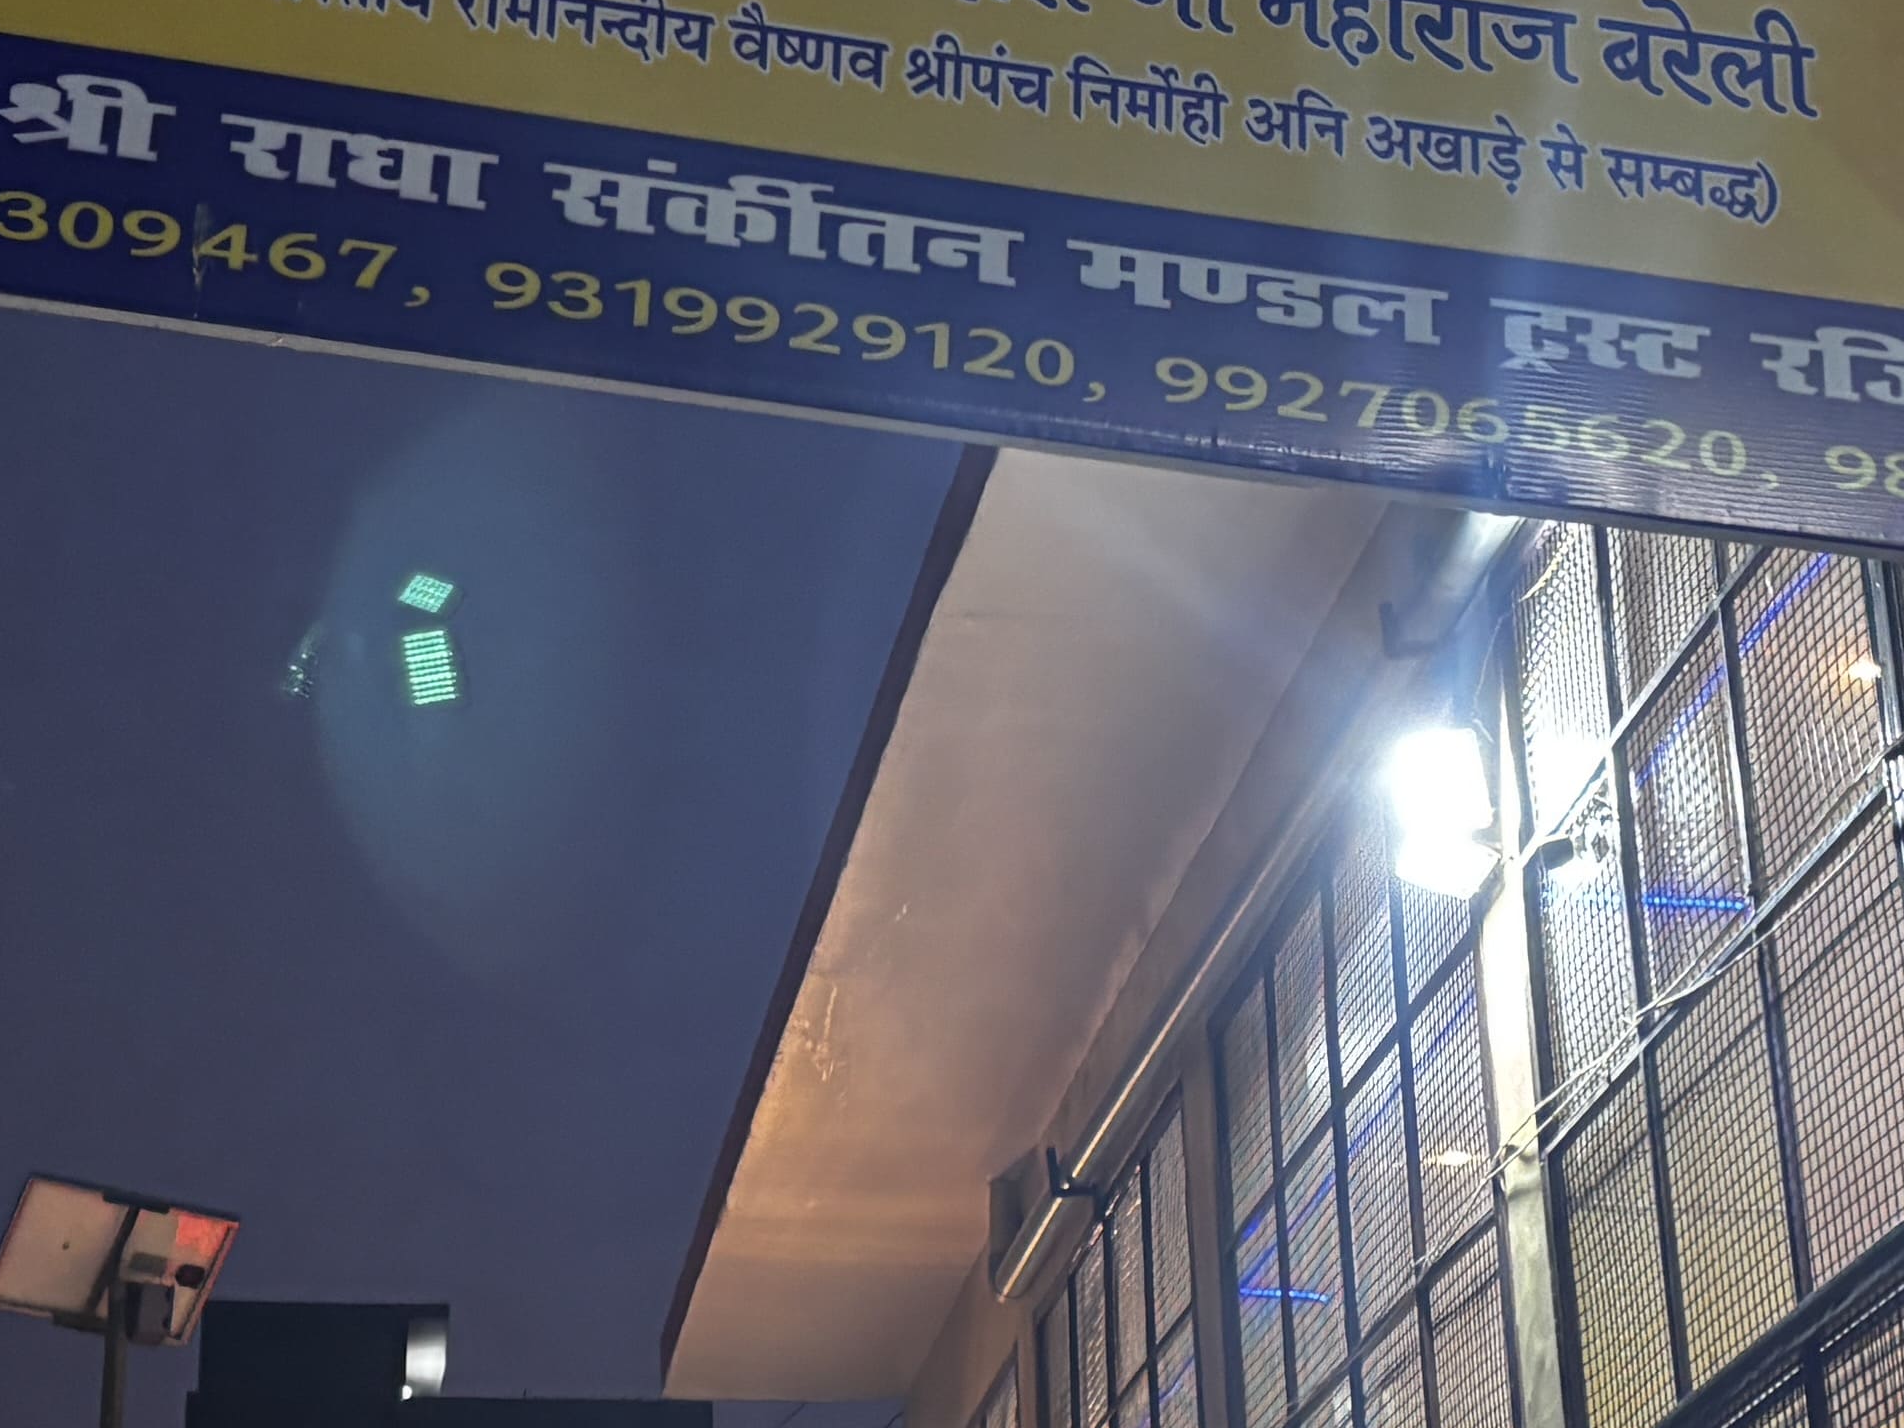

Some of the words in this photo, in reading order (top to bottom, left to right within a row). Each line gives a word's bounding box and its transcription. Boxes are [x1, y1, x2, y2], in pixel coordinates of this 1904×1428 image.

[729, 4, 888, 88] वैष्णव
[905, 34, 1051, 113] श्रीपंच
[1247, 90, 1347, 157] अनि
[1368, 114, 1525, 195] अखाड़े
[1542, 124, 1586, 191] से
[1602, 147, 1778, 225] सम्बद्ध)
[222, 112, 500, 212] राधा
[1068, 236, 1449, 346] मण्डल
[1490, 297, 1710, 378] ट्रस्ट
[484, 261, 1108, 404] 9319929120,
[1154, 357, 1781, 492] 9927065620,
